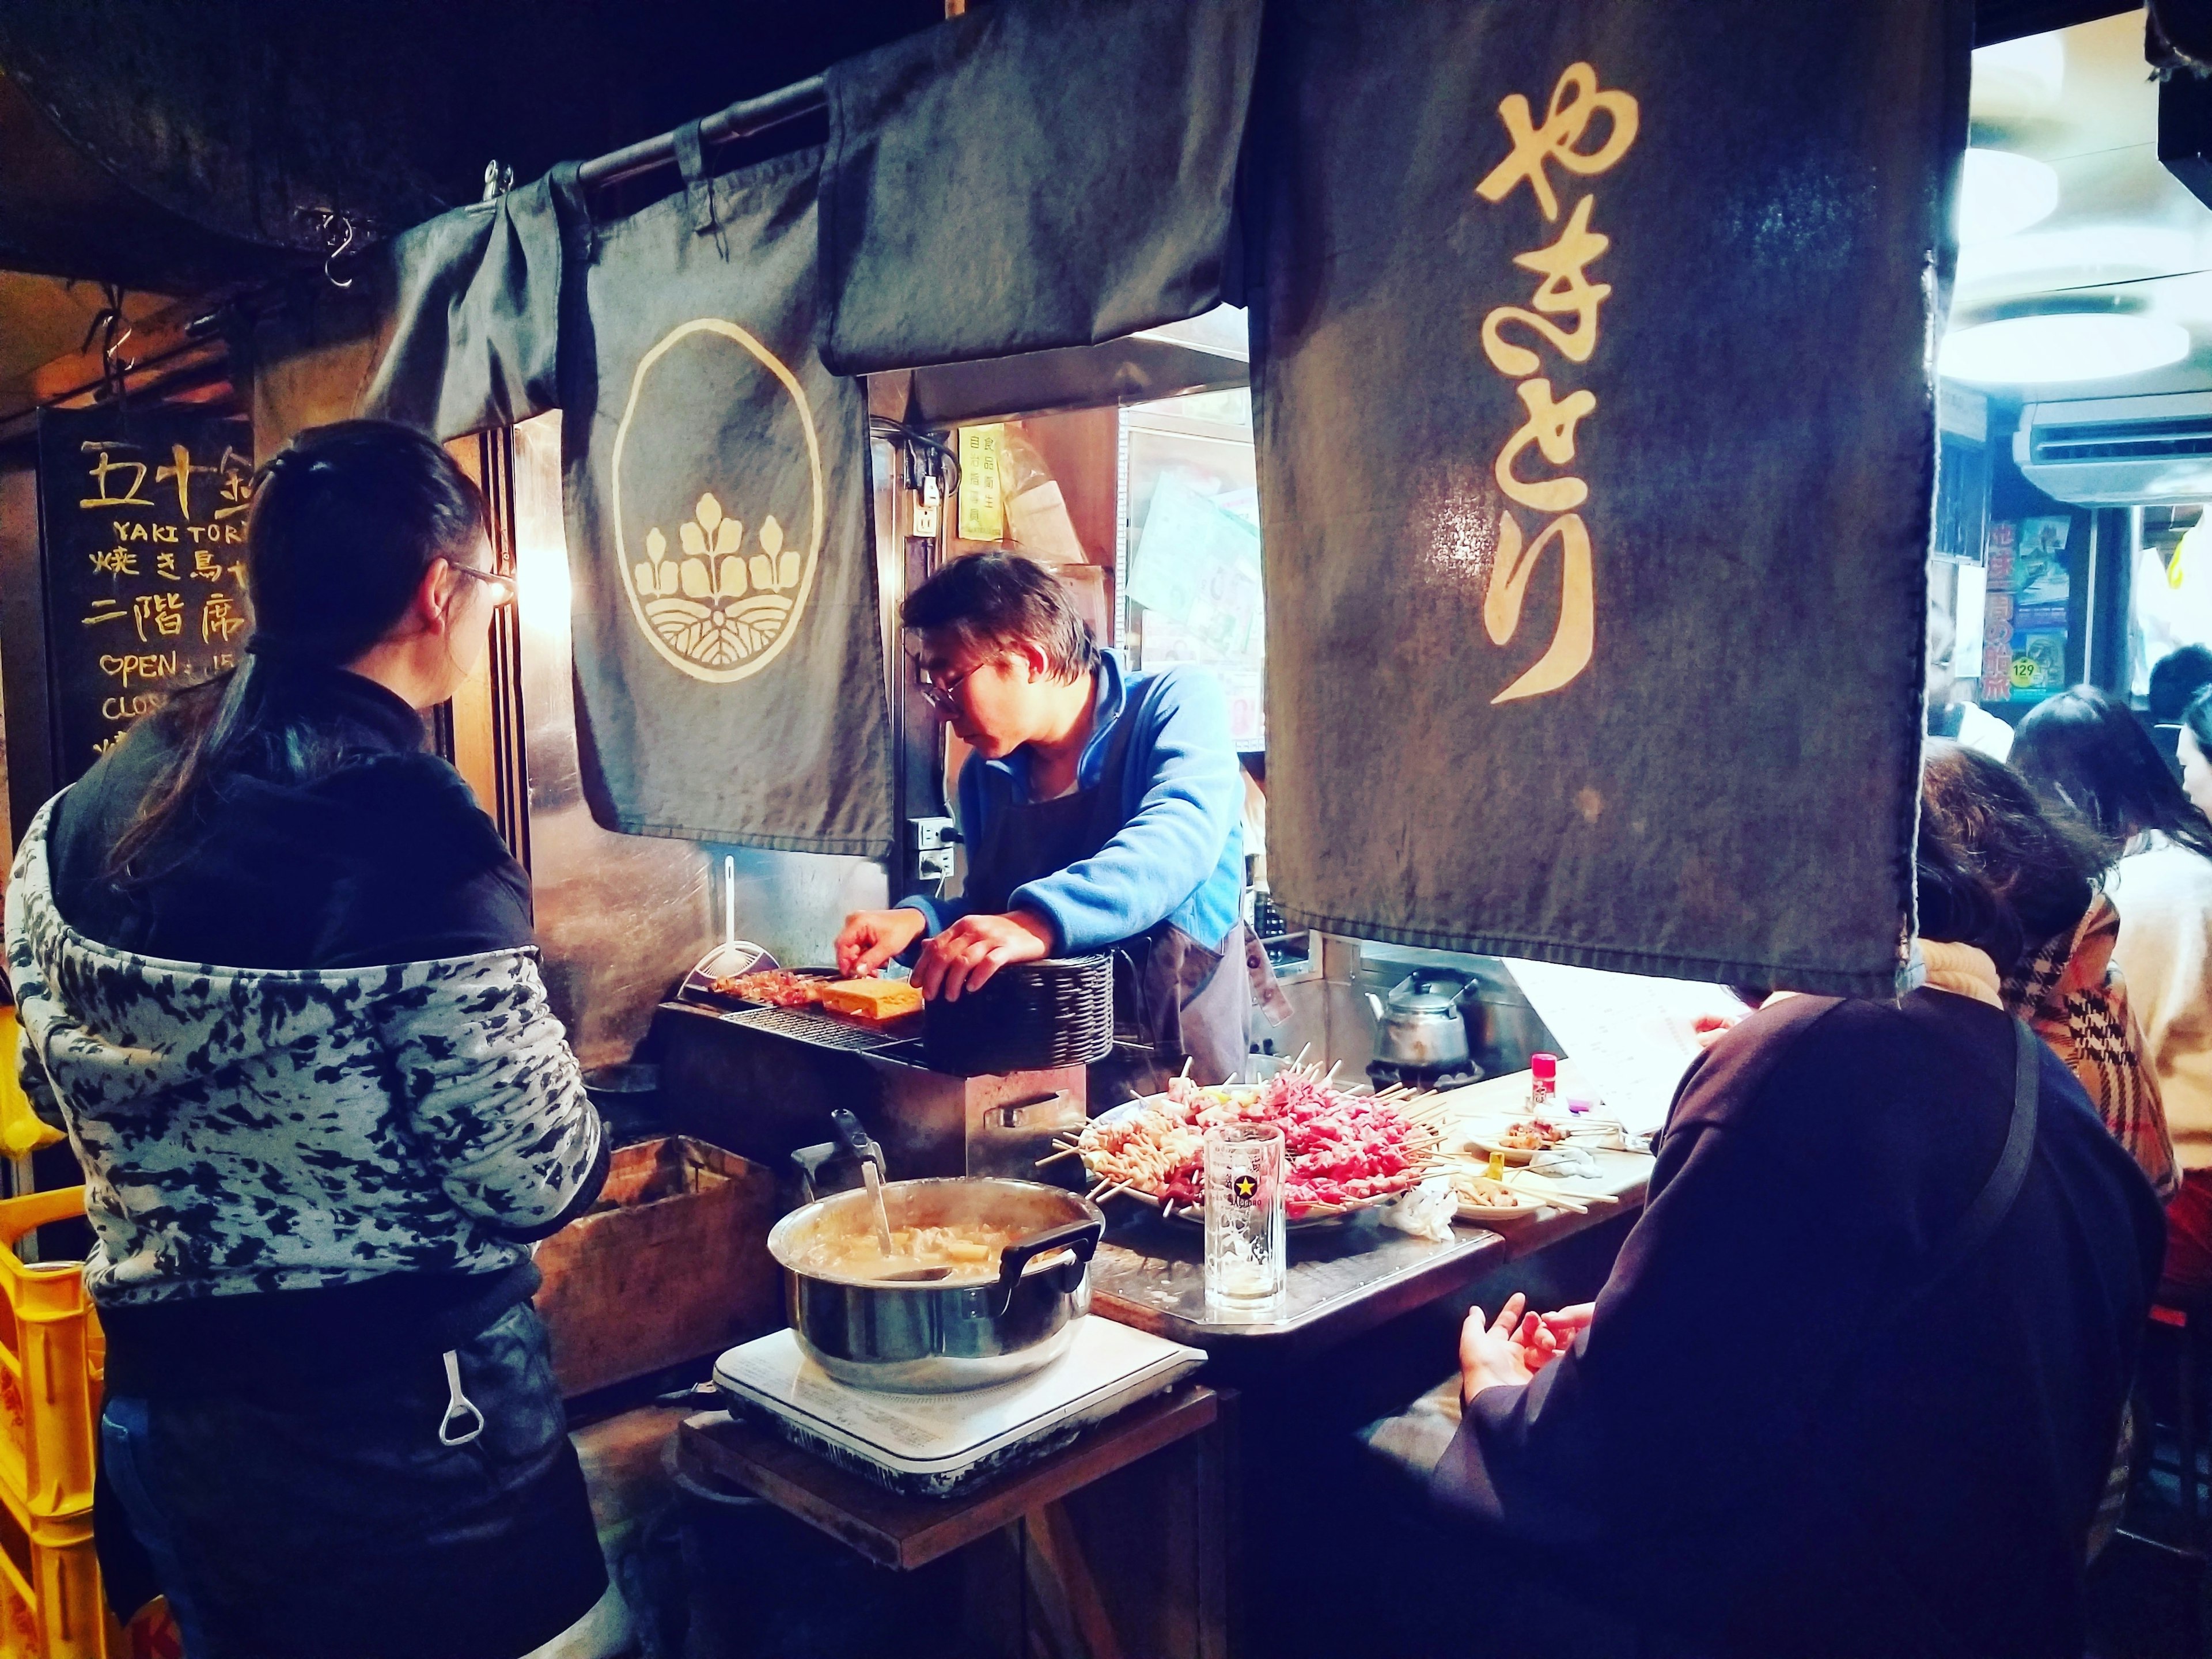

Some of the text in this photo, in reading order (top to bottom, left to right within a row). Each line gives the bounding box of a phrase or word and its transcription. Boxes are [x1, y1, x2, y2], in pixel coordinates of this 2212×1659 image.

[1475, 61, 1639, 704] やきとり
[81, 592, 245, 644] 二階席
[2014, 665, 2034, 676] 129
